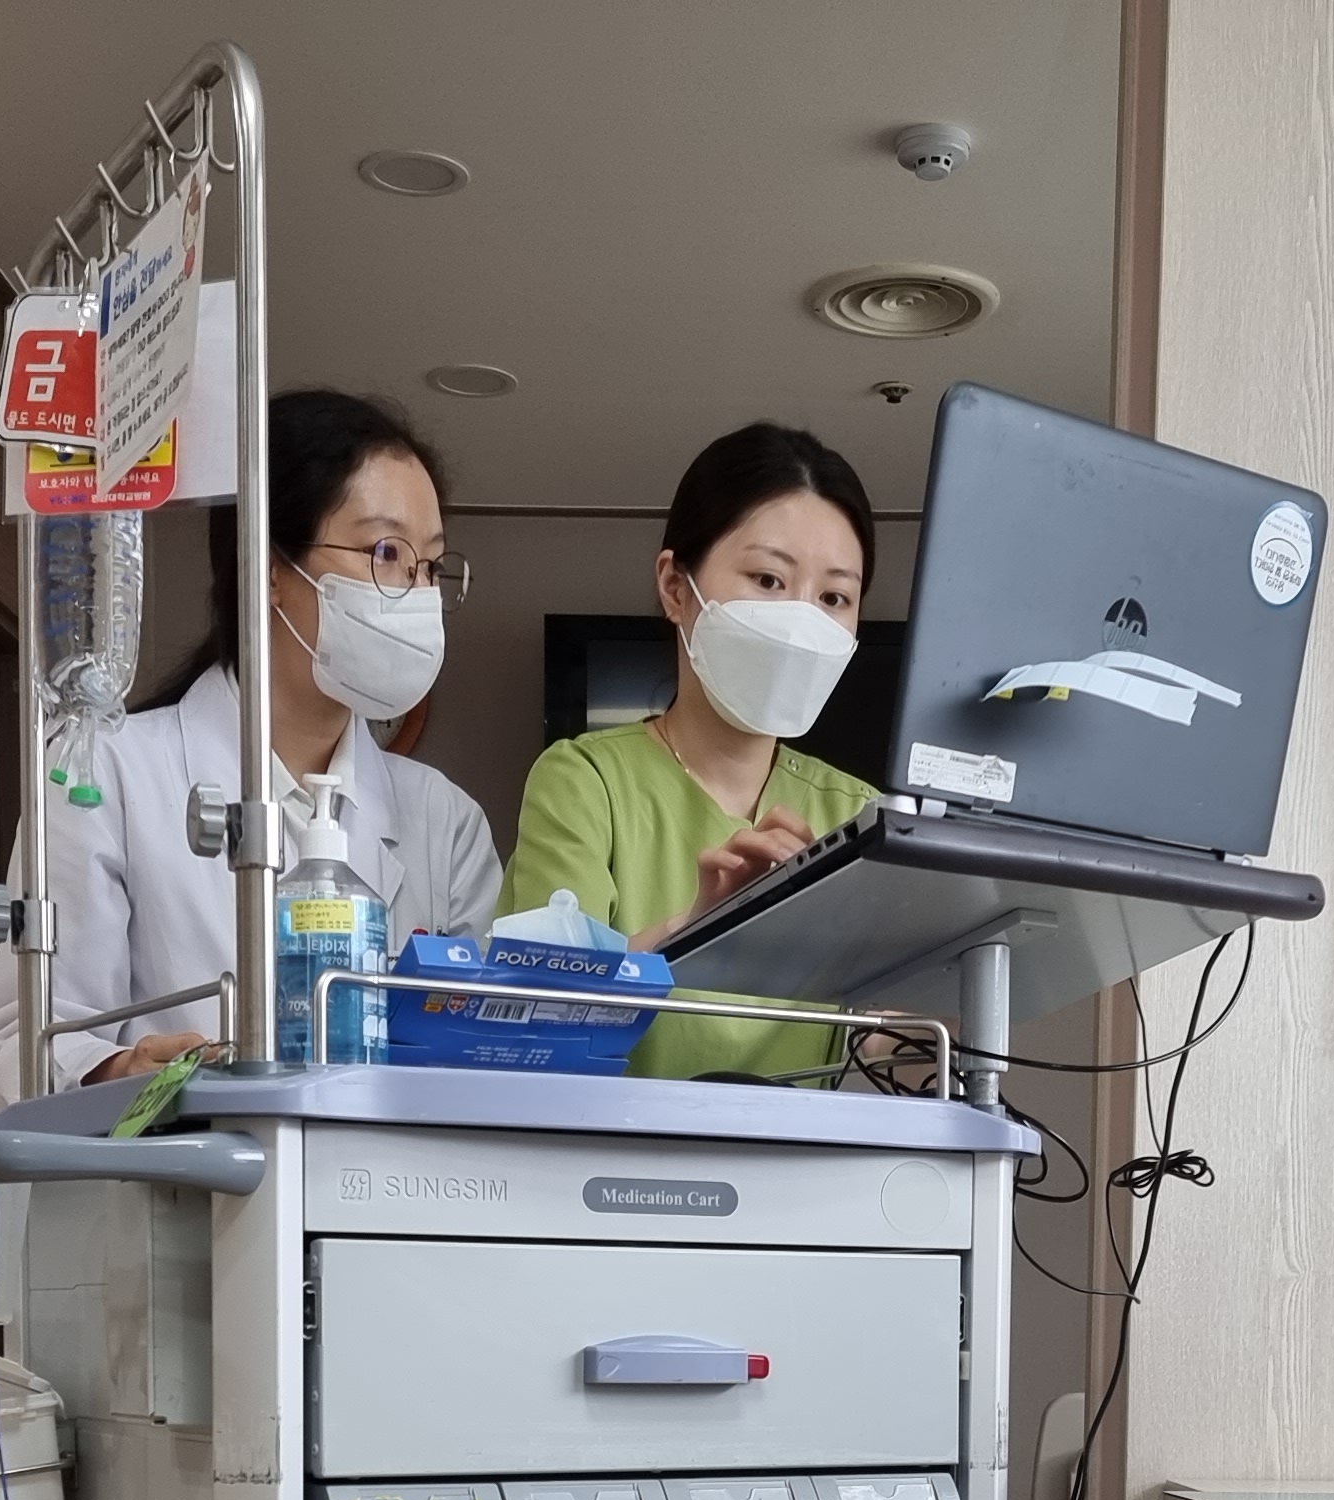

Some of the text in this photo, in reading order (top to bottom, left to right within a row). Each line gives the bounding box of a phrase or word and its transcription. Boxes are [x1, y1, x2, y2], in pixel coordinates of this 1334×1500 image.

[24, 340, 66, 402] 금
[34, 412, 76, 434] 드시면
[494, 951, 544, 967] POLY
[547, 958, 609, 975] GLOVE
[288, 1000, 310, 1011] 70%
[384, 1176, 508, 1202] SUNGSIM
[601, 1188, 721, 1208] Medication Cart
